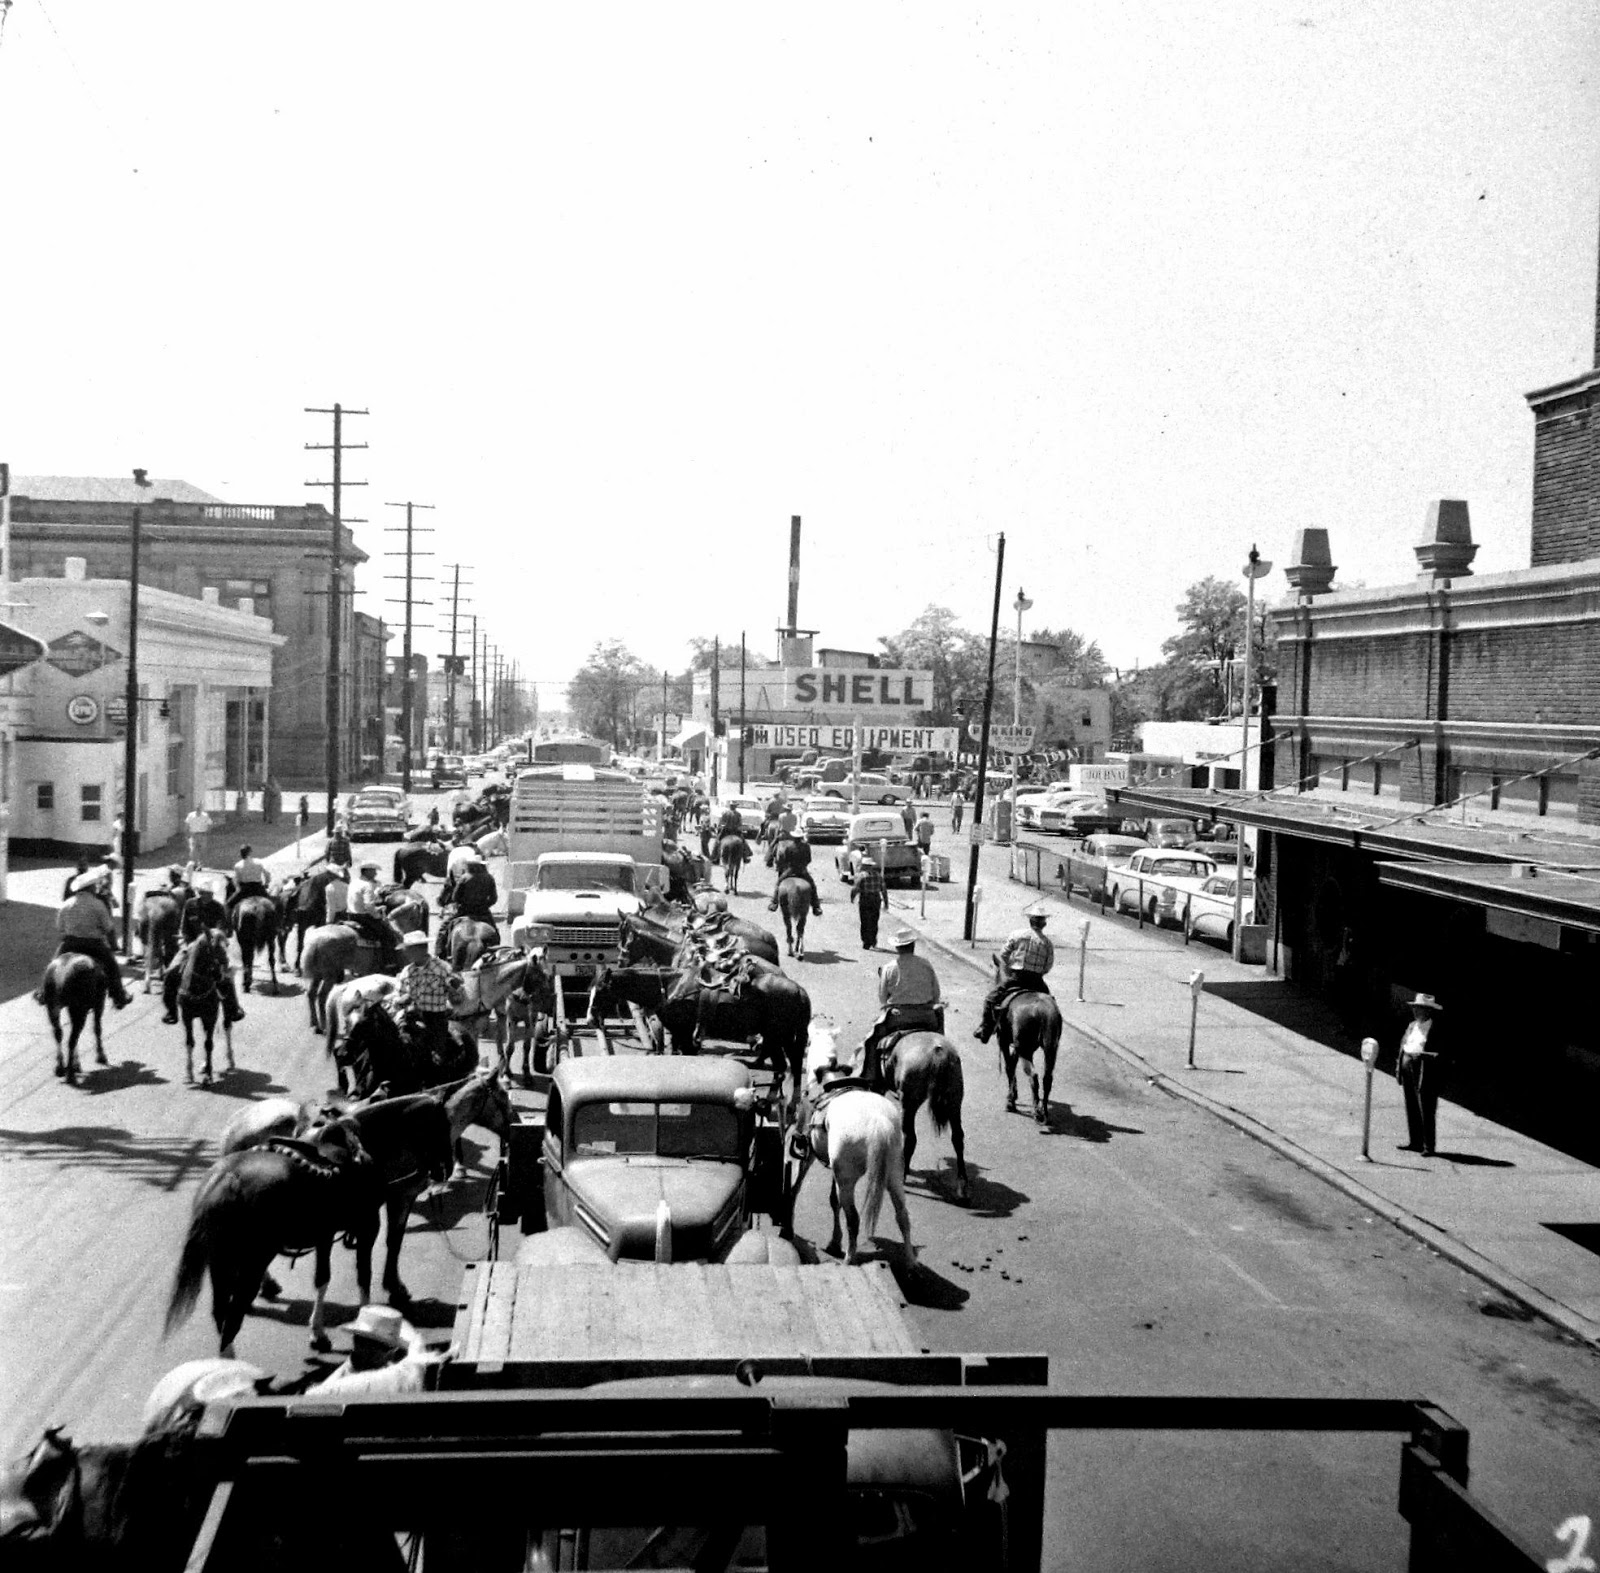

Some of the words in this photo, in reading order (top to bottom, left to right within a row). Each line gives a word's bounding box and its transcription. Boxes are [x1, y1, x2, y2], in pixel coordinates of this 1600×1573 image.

[794, 673, 925, 705] SHELL
[774, 727, 819, 748] USED
[972, 726, 1032, 737] PRKING
